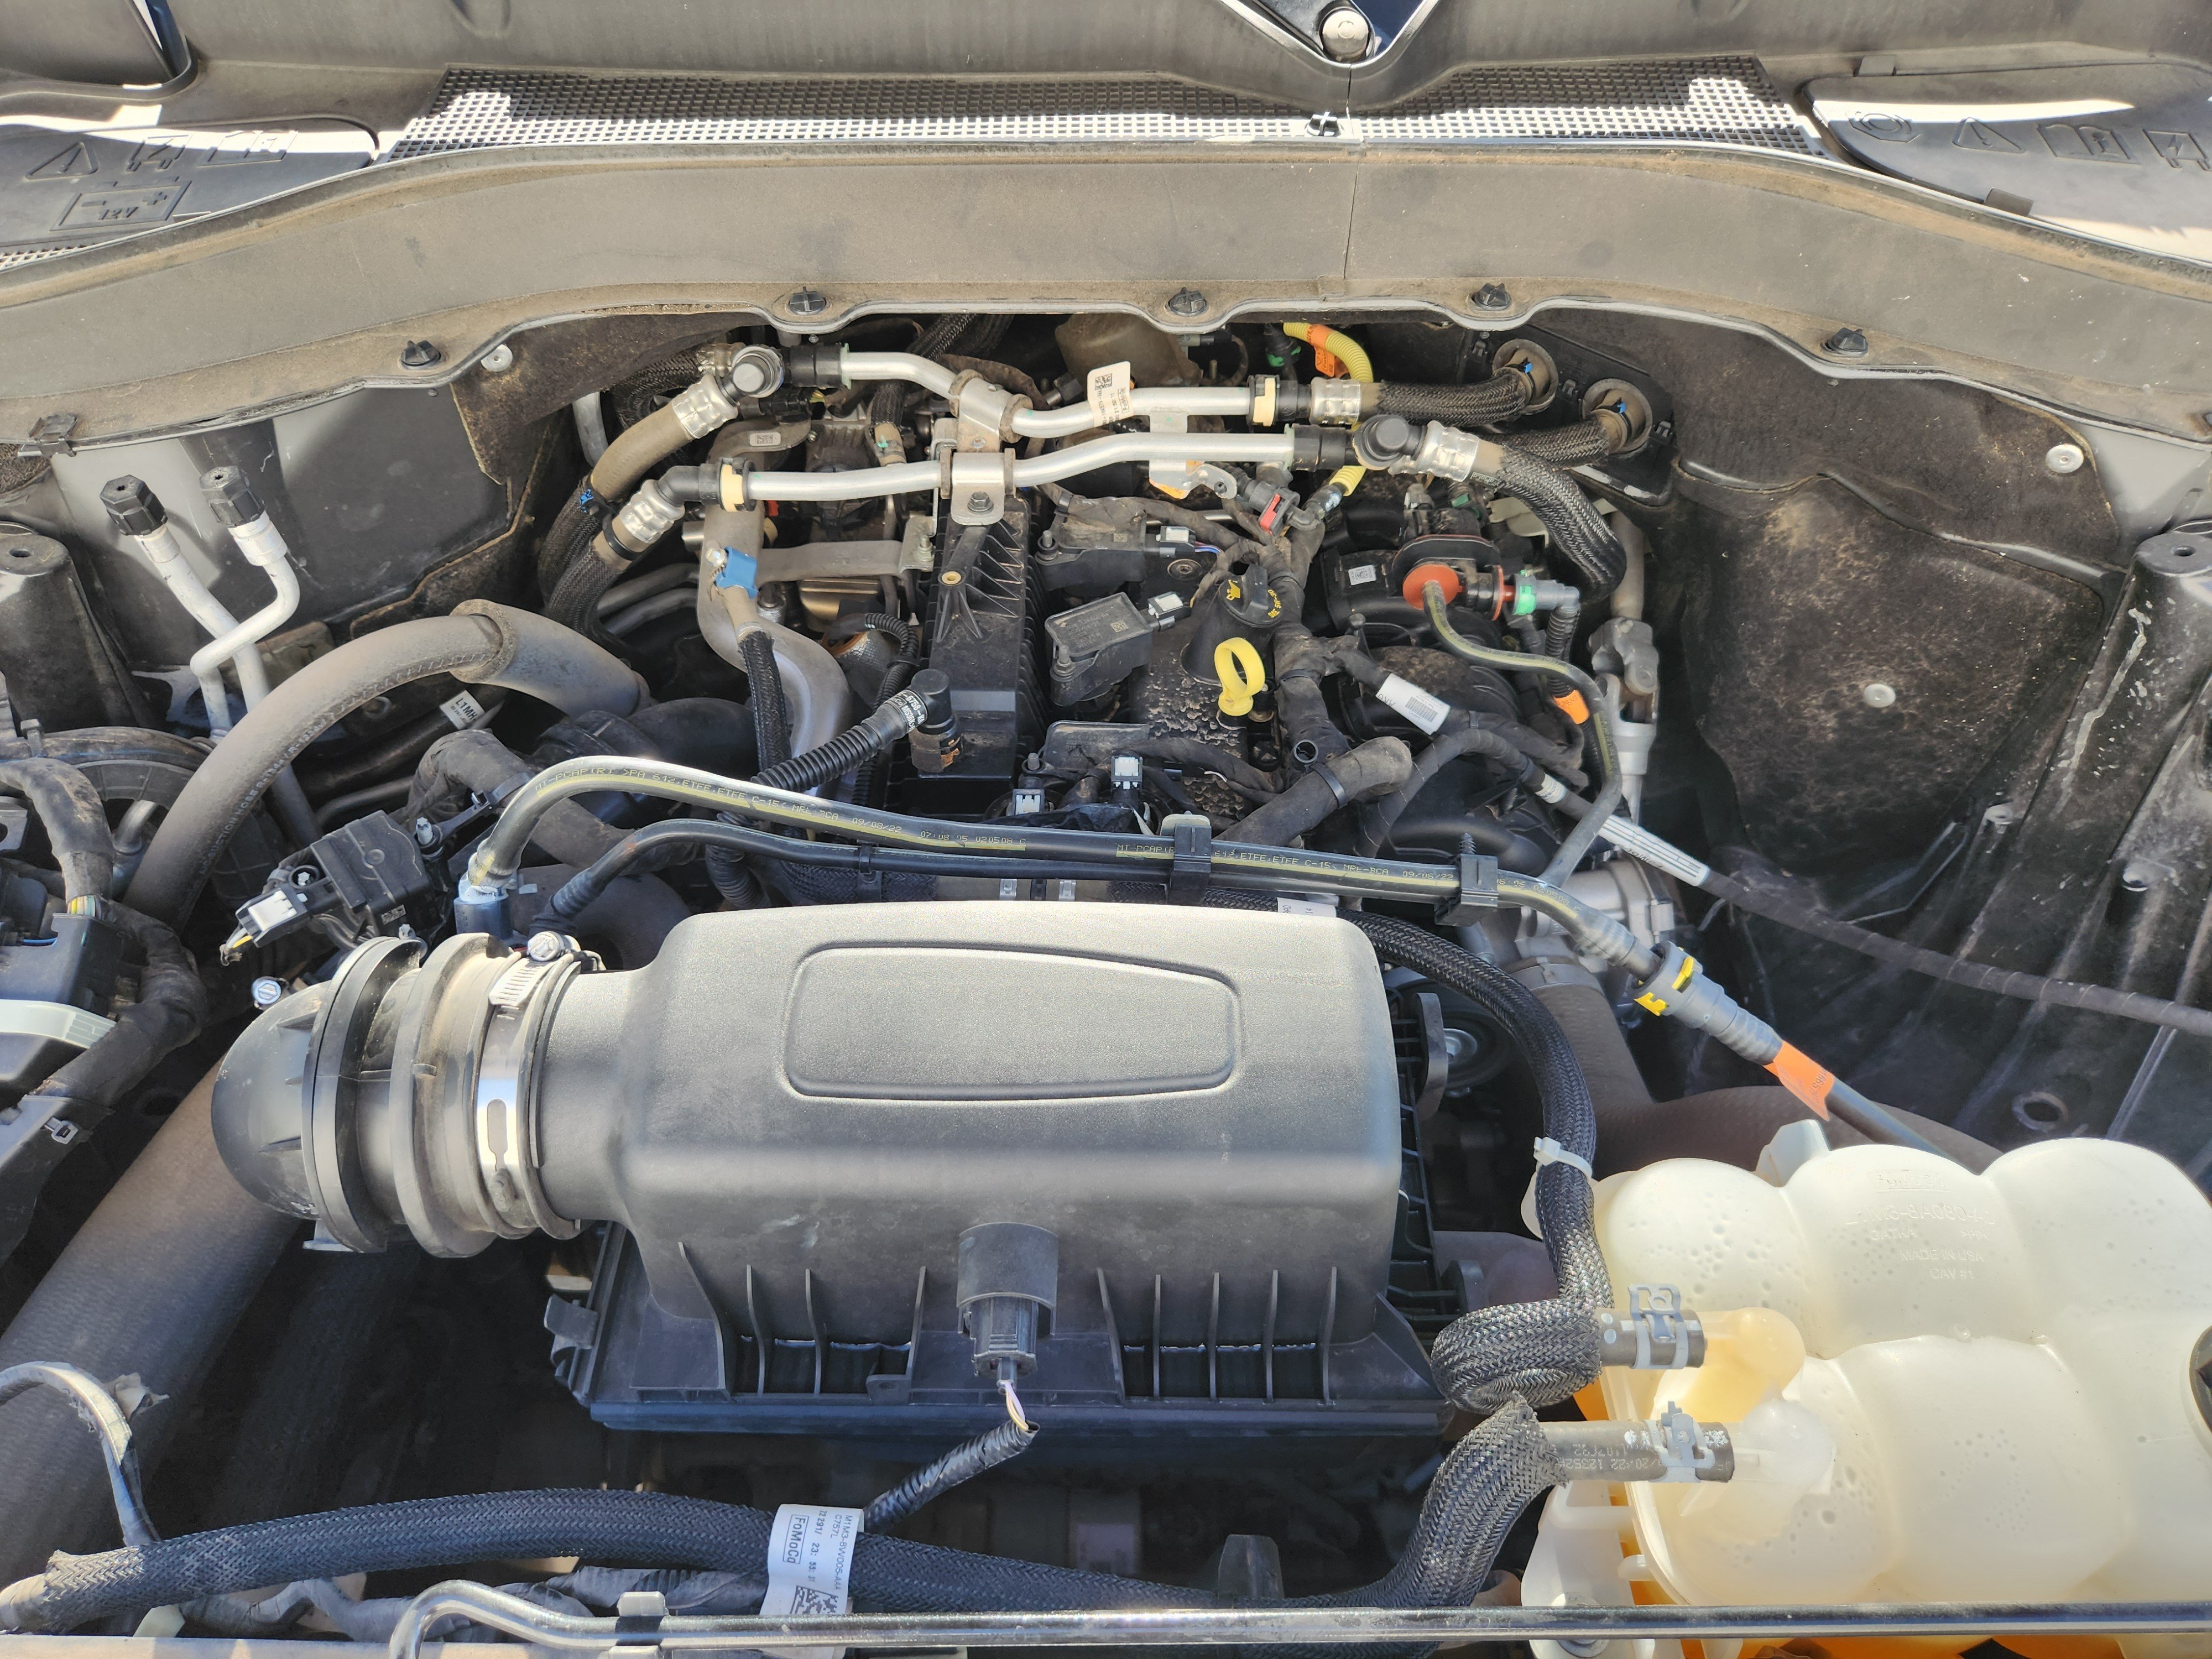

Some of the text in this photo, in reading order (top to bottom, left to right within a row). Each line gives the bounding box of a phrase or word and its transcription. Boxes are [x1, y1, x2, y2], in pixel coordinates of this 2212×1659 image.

[1267, 608, 1280, 618] SAE
[852, 817, 902, 833] 09/08/22
[1899, 1249, 1985, 1262] MADE IN USA
[1929, 1267, 1957, 1280] CAV
[787, 1516, 806, 1564] FoMoCo
